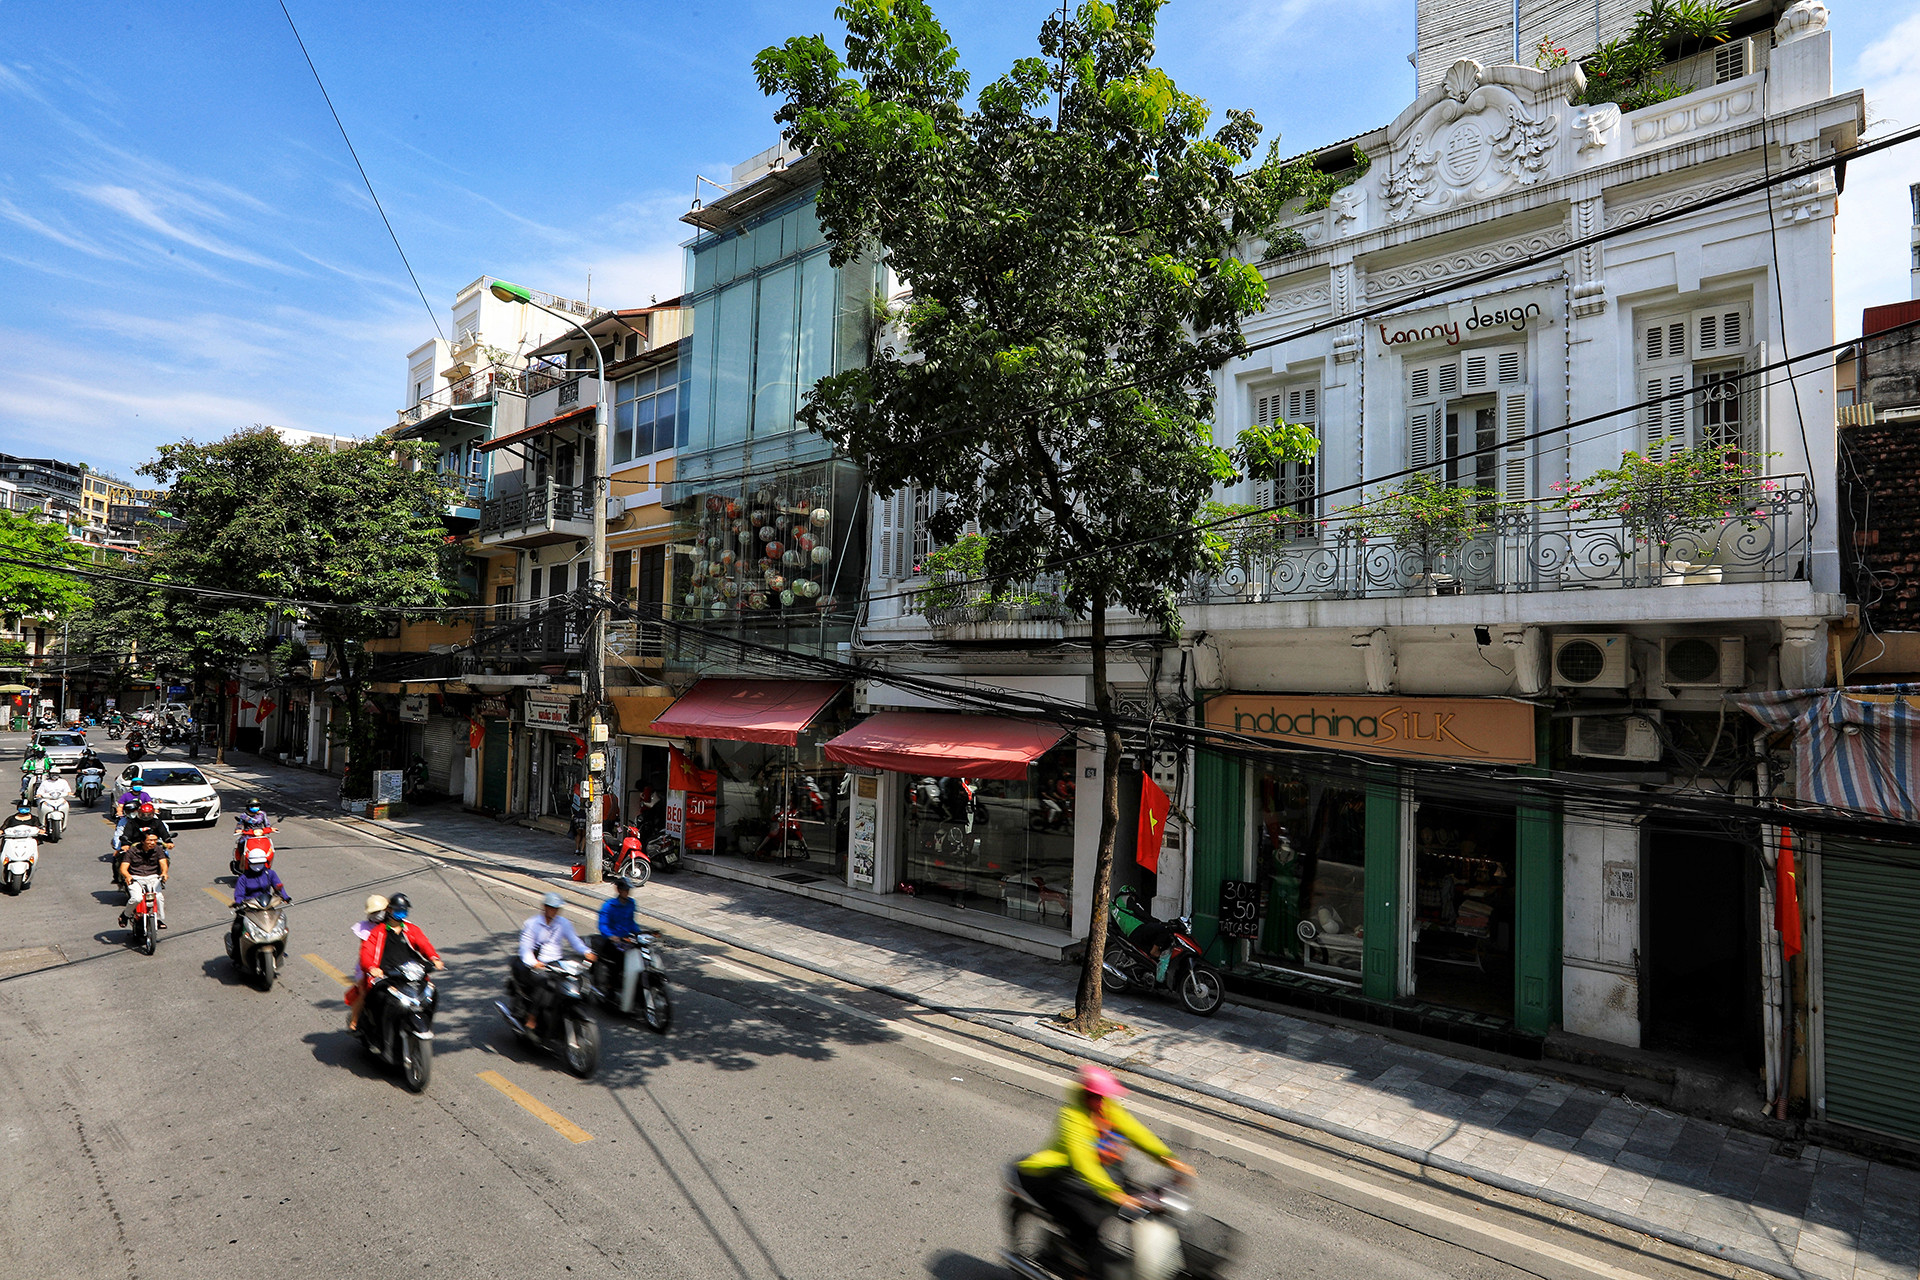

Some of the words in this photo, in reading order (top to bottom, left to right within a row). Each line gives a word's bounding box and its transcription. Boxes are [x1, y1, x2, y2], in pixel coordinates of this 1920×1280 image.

[1379, 321, 1460, 345] tanmy
[1465, 303, 1541, 332] design
[1234, 706, 1378, 738] indochina
[666, 803, 682, 823] BÉO
[690, 800, 704, 814] 50
